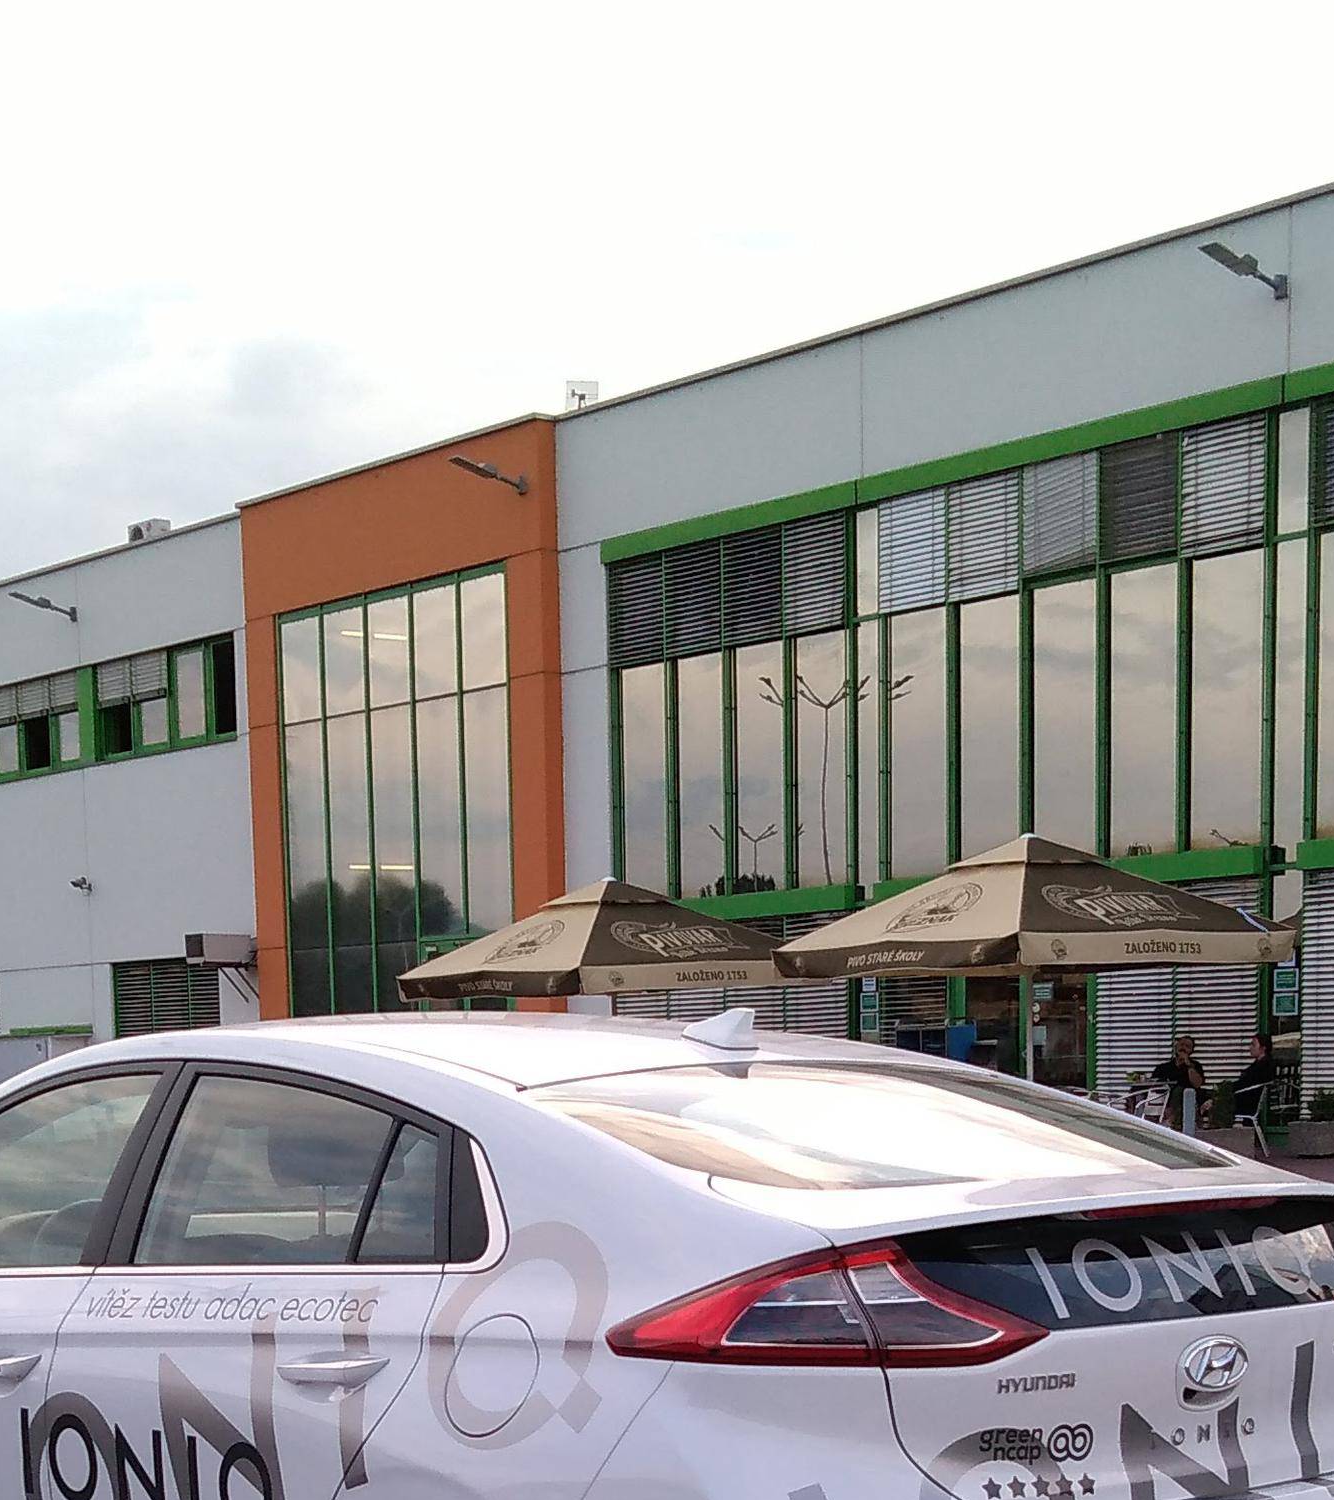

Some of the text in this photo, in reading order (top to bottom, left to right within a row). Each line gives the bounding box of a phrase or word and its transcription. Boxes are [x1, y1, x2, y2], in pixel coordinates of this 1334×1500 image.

[638, 927, 720, 957] PIVOVAR
[1124, 939, 1177, 955] ZALOŽENO
[846, 955, 866, 968] PIVO
[676, 970, 724, 983] ZALOŽENO
[1025, 1226, 1317, 1319] IONIQ
[142, 1289, 200, 1319] testu
[204, 1282, 277, 1321] adac
[280, 1291, 379, 1323] ecotec
[997, 1372, 1076, 1394] HYUNDAI
[979, 1428, 1043, 1452] green
[993, 1446, 1041, 1466] ncap
